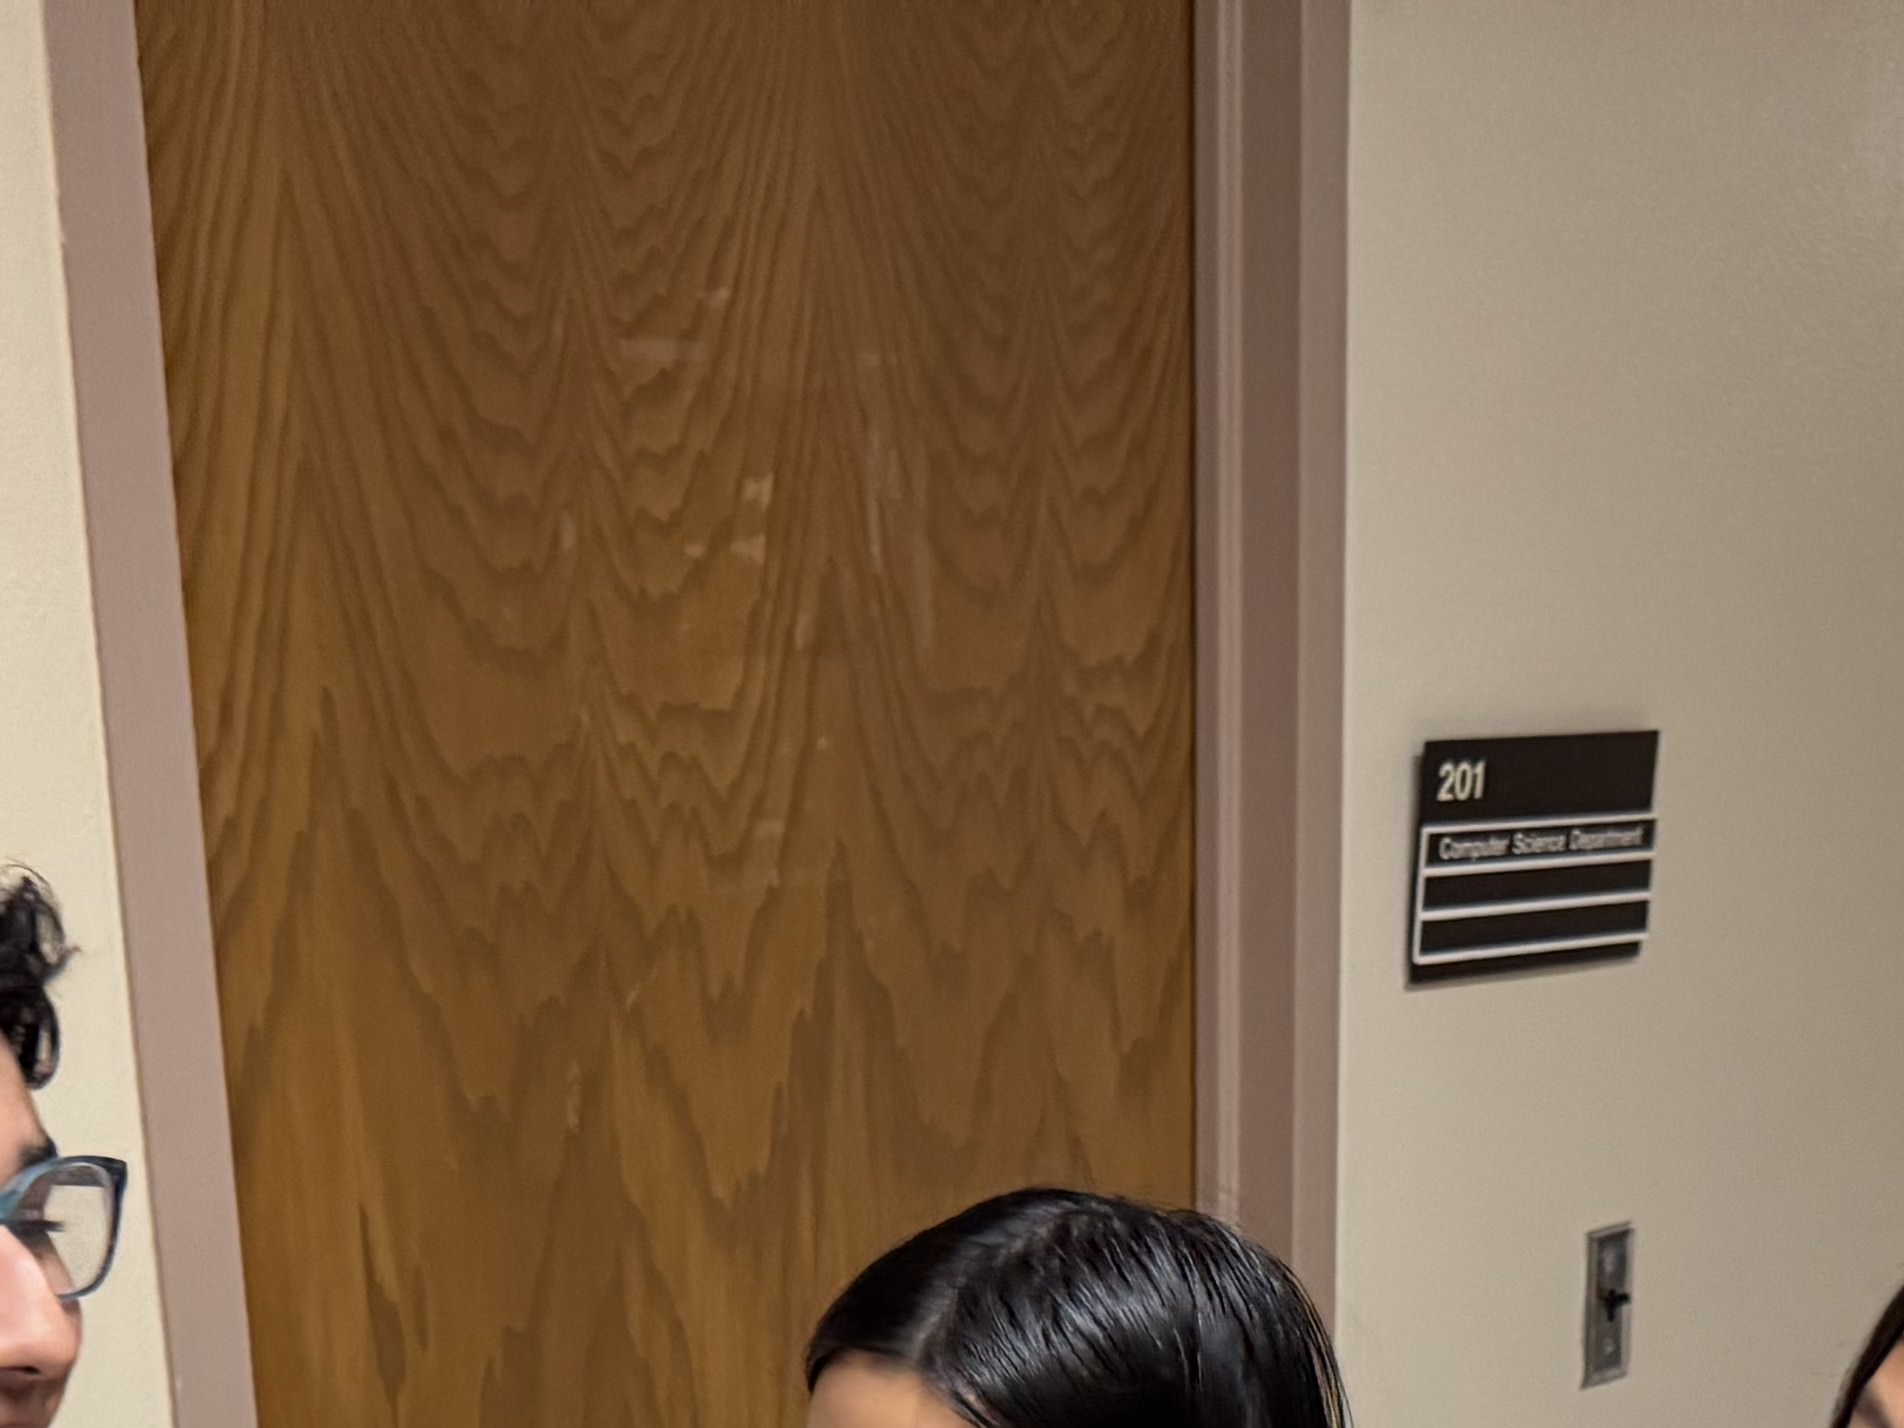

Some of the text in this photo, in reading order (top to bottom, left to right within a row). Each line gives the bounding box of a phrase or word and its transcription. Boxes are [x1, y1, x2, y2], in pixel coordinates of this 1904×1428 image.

[1437, 760, 1486, 801] 201
[1438, 826, 1644, 861] Computer Science Department
